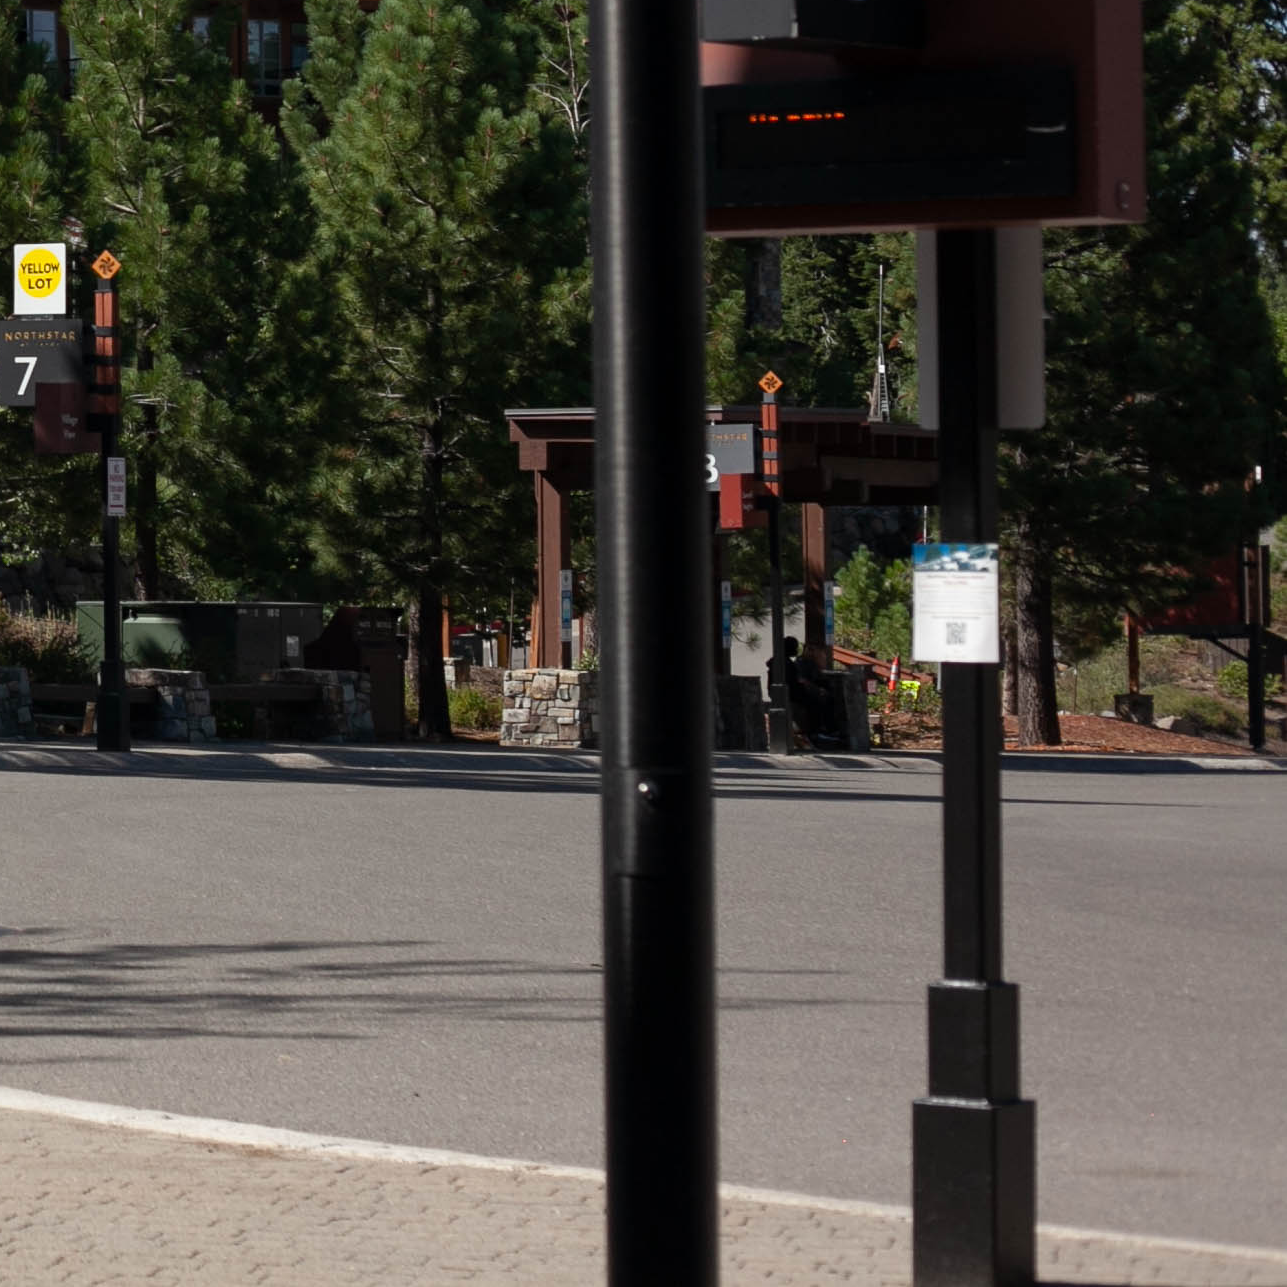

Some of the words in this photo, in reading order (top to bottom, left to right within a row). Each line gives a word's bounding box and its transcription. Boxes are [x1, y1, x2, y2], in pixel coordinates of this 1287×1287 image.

[20, 263, 60, 273] YELLOW
[28, 278, 53, 289] LOT
[5, 331, 75, 341] NORTHSTAR
[14, 357, 37, 395] 7
